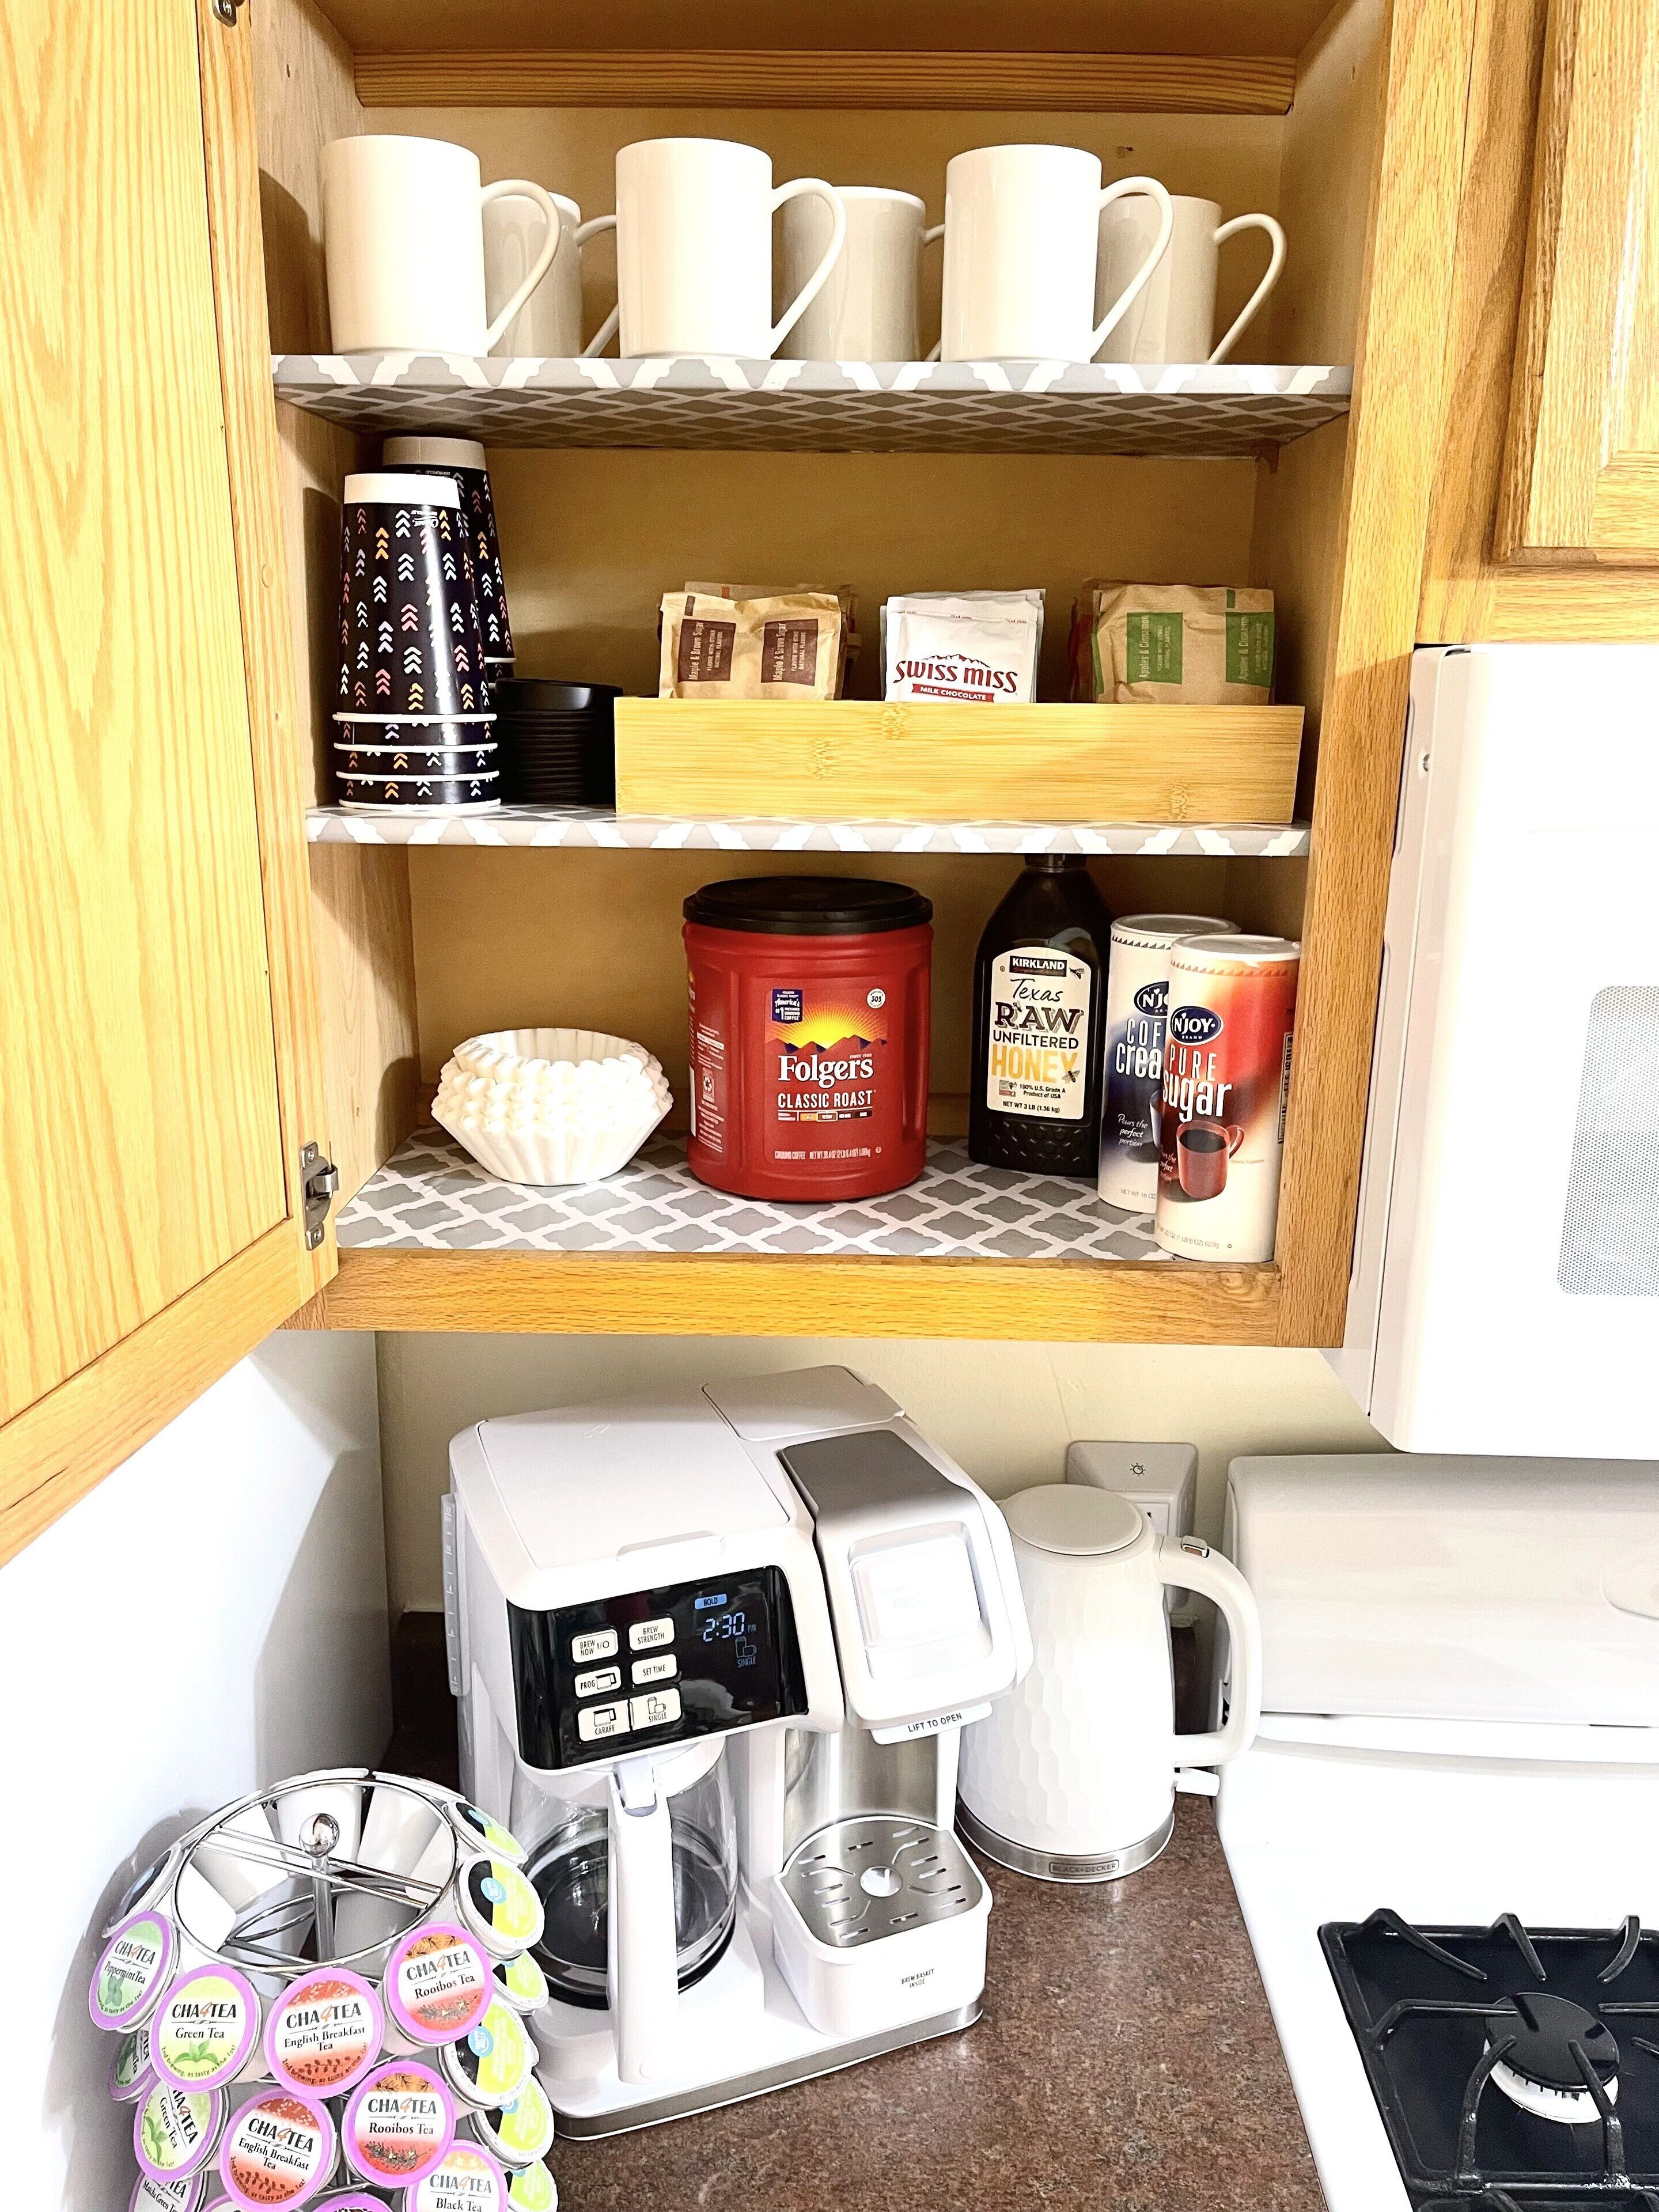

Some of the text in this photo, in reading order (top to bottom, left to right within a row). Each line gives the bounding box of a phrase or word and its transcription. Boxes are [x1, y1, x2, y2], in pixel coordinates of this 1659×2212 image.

[692, 622, 705, 636] Sugar
[1139, 615, 1150, 648] Cinnamon
[691, 637, 702, 655] Brown
[775, 638, 786, 654] Brown
[688, 661, 700, 680] Maple
[773, 661, 784, 681] Maple
[893, 660, 958, 684] SWISS
[1138, 656, 1150, 679] Apples
[1238, 657, 1249, 680] Apples
[920, 686, 986, 701] MILK CHOCOLATE
[1013, 958, 1065, 970] KIRKLAND
[1010, 979, 1063, 1002] Texas
[775, 998, 800, 1007] America's
[995, 1001, 1084, 1035] RAW
[993, 1029, 1079, 1049] UNFILTERED
[991, 1044, 1078, 1084] HONEY
[1116, 1043, 1162, 1080] crea
[1169, 1044, 1217, 1081] PURE
[778, 1054, 873, 1089] Folgers
[778, 1090, 873, 1108] CLASSIC ROAST
[1163, 1070, 1232, 1123] sugar
[1118, 1113, 1148, 1128] Pours the
[1119, 1128, 1143, 1138] perfect
[1119, 1139, 1142, 1147] portion
[774, 1151, 791, 1159] GROUND
[792, 1151, 806, 1160] COFFEE
[703, 1597, 718, 1606] BOLD
[643, 1626, 658, 1635] BREW
[703, 1612, 757, 1642] 2:30 PM
[580, 1639, 595, 1649] BREW
[638, 1633, 665, 1645] STRENGTH
[581, 1647, 594, 1656] NOW
[643, 1664, 666, 1676] SET TIME
[737, 1656, 756, 1668] SINGLE
[580, 1680, 596, 1690] PROG
[649, 1712, 667, 1723] SINGLE
[908, 1722, 925, 1732] LIFT
[940, 1713, 962, 1725] OPEN
[595, 1725, 615, 1736] CARAFE
[115, 1941, 156, 1965] CHA4TEA
[105, 1961, 146, 1984] Peppermint Tea
[406, 1950, 471, 1980] CHA4TEA
[902, 1968, 934, 1984] BREW BASKET
[415, 1974, 476, 1999] Rooibos Tea
[172, 2001, 236, 2018] CHA4TEA
[286, 2002, 362, 2029] CHA4TEA
[176, 2027, 224, 2039] Green Tea
[284, 2025, 365, 2048] English Breakfast
[317, 2042, 334, 2051] Tea
[217, 2058, 226, 2067] the
[282, 2058, 292, 2071] 2nd
[368, 2097, 437, 2114] CHA4TEA
[160, 2097, 177, 2149] Green Tea
[369, 2122, 434, 2134] Rooibos Tea
[248, 2118, 313, 2153] CHA4TEA
[238, 2137, 309, 2171] English Breakfast
[263, 2157, 276, 2170] Tea
[430, 2174, 491, 2194] CHA4TEA
[143, 2180, 156, 2199] Matcha
[156, 2194, 169, 2210] Green
[436, 2198, 482, 2212] Black Tea
